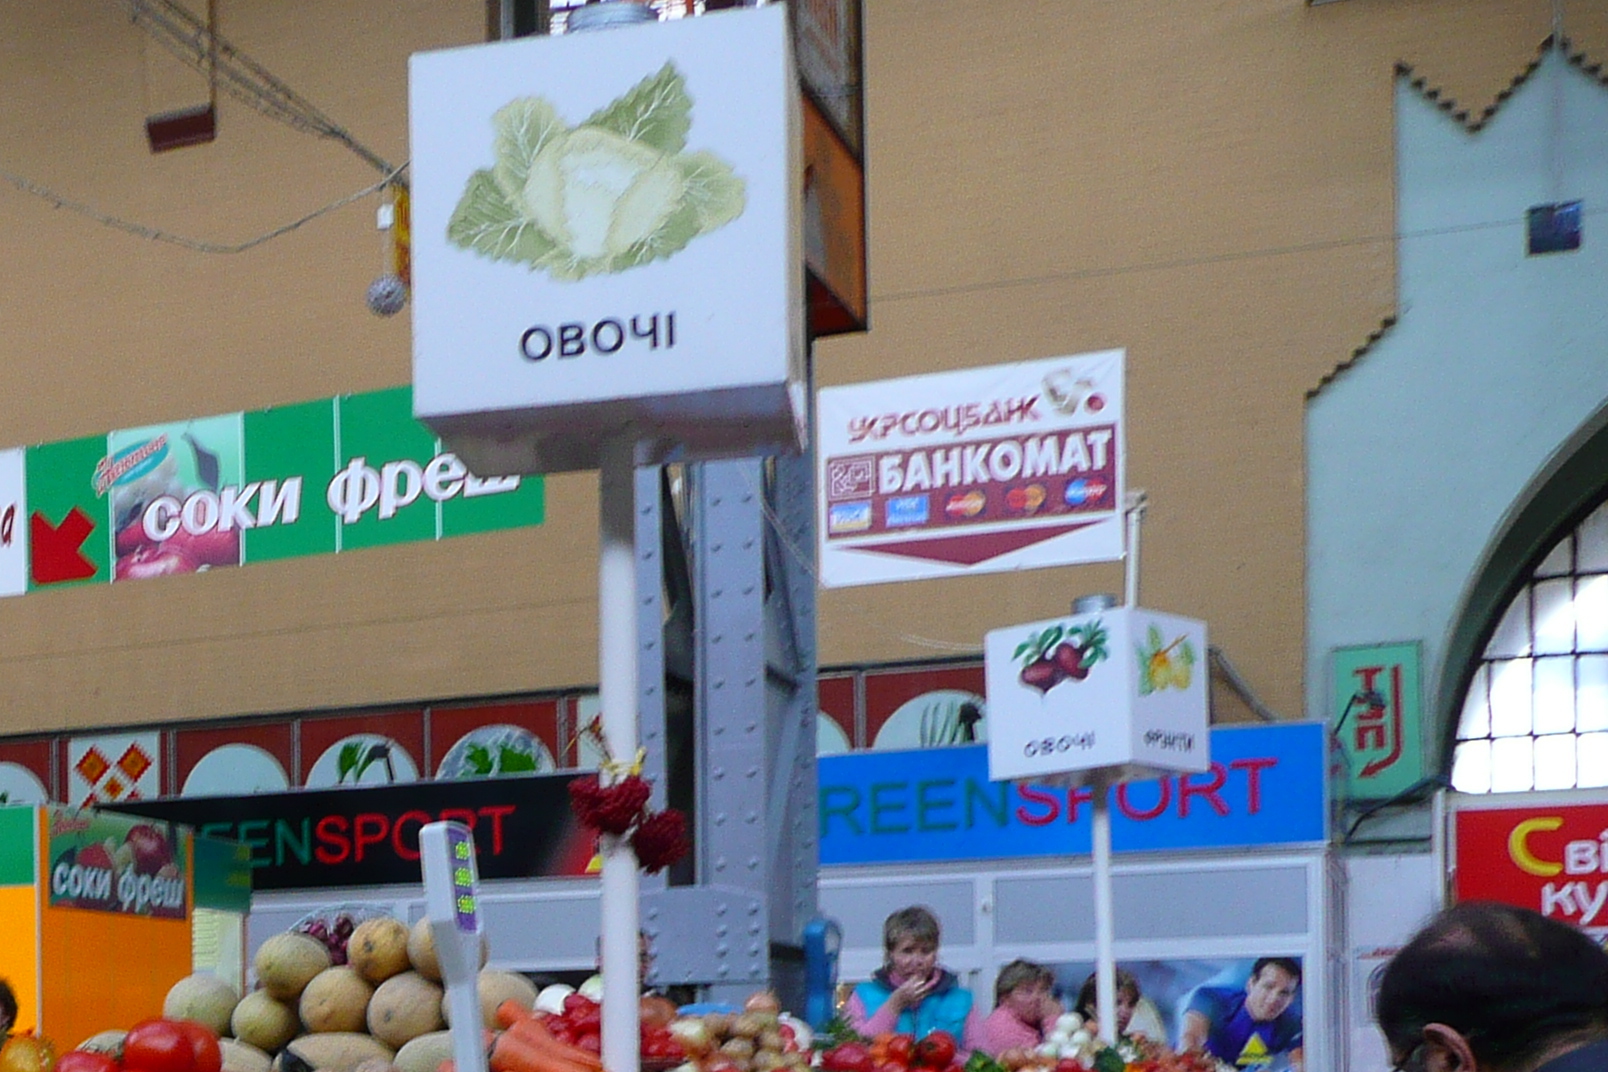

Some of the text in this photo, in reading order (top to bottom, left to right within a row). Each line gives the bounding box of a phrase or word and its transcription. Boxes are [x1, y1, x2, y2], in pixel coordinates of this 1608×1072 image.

[520, 309, 677, 362] ОВОЧІ
[848, 394, 1041, 442] УКРСОЦБАНК
[878, 430, 1113, 494] БАНКОМАТ
[142, 452, 520, 542] соки фре
